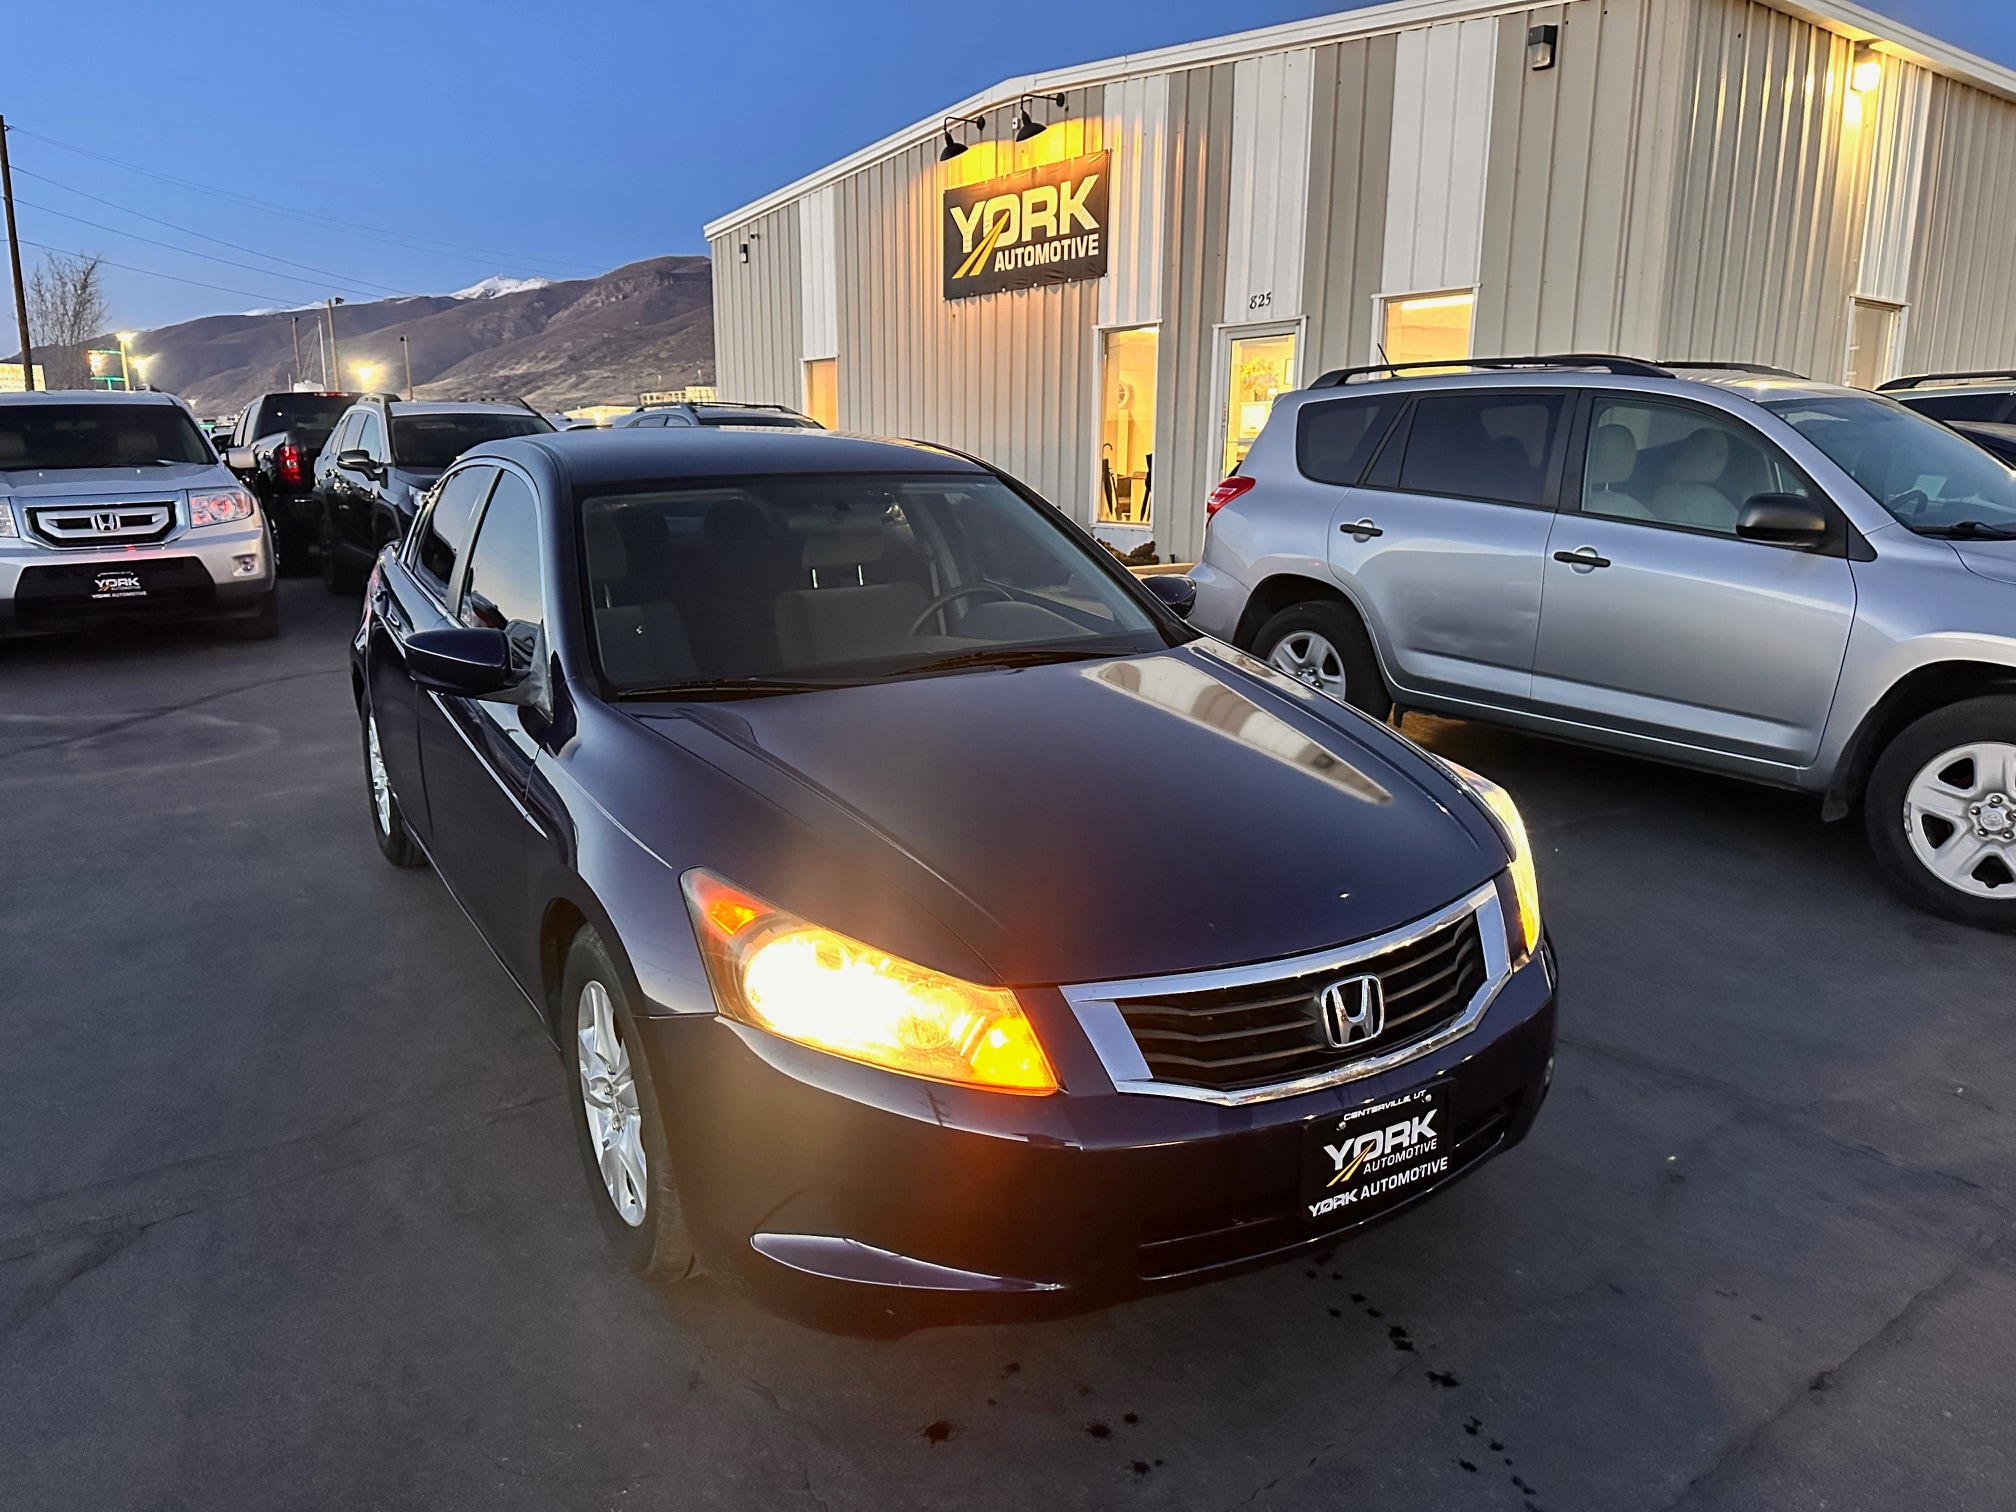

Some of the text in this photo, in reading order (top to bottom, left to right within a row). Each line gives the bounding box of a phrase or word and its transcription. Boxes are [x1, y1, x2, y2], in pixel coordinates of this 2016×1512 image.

[950, 174, 1100, 254] YORK
[994, 233, 1099, 272] AUTOMOTIVE
[1249, 291, 1272, 310] 825
[94, 577, 140, 587] YORK
[1413, 1089, 1427, 1100] UT
[1323, 1108, 1438, 1171] YORK
[1363, 1138, 1438, 1175] AUTOMOTIVE
[1308, 1156, 1448, 1217] YORK AUTOMOTIVE
